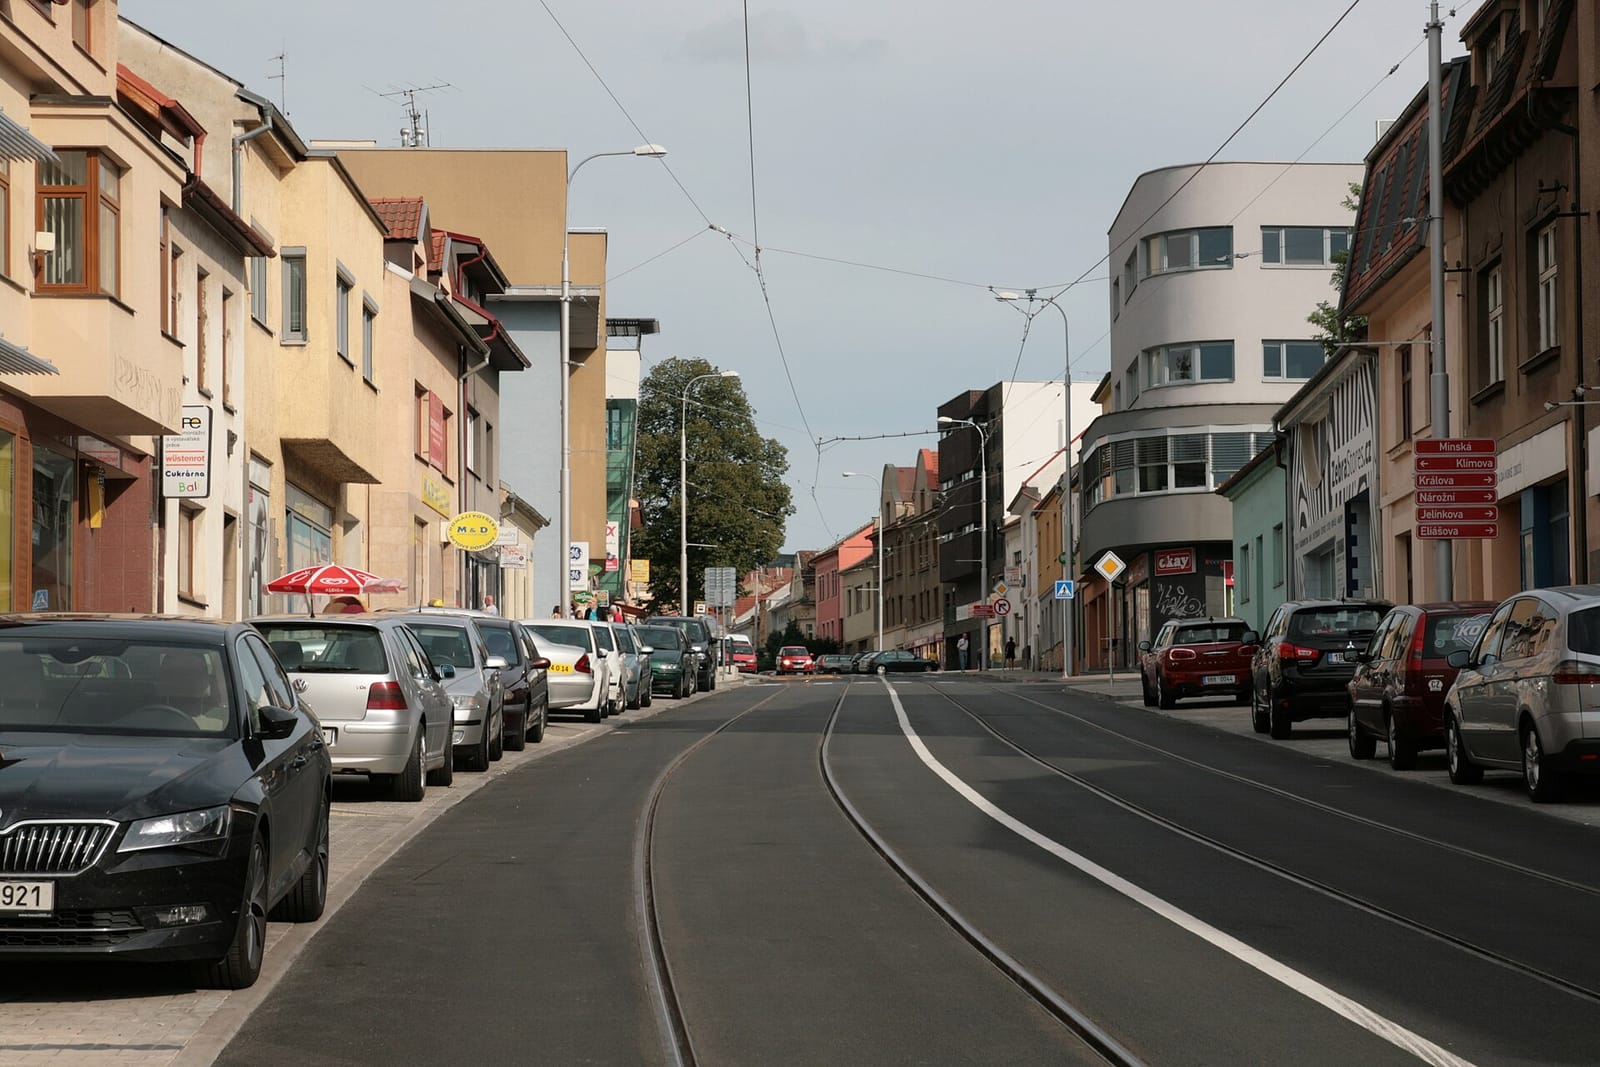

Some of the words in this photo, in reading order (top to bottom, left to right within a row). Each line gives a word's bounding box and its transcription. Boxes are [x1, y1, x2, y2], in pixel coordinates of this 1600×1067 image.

[1439, 442, 1472, 451] Minská
[165, 454, 205, 462] wüstenrot
[165, 469, 205, 477] Cukrárna
[1418, 475, 1454, 485] Králova
[1420, 526, 1459, 536] Eliášova
[2, 885, 41, 907] 921
